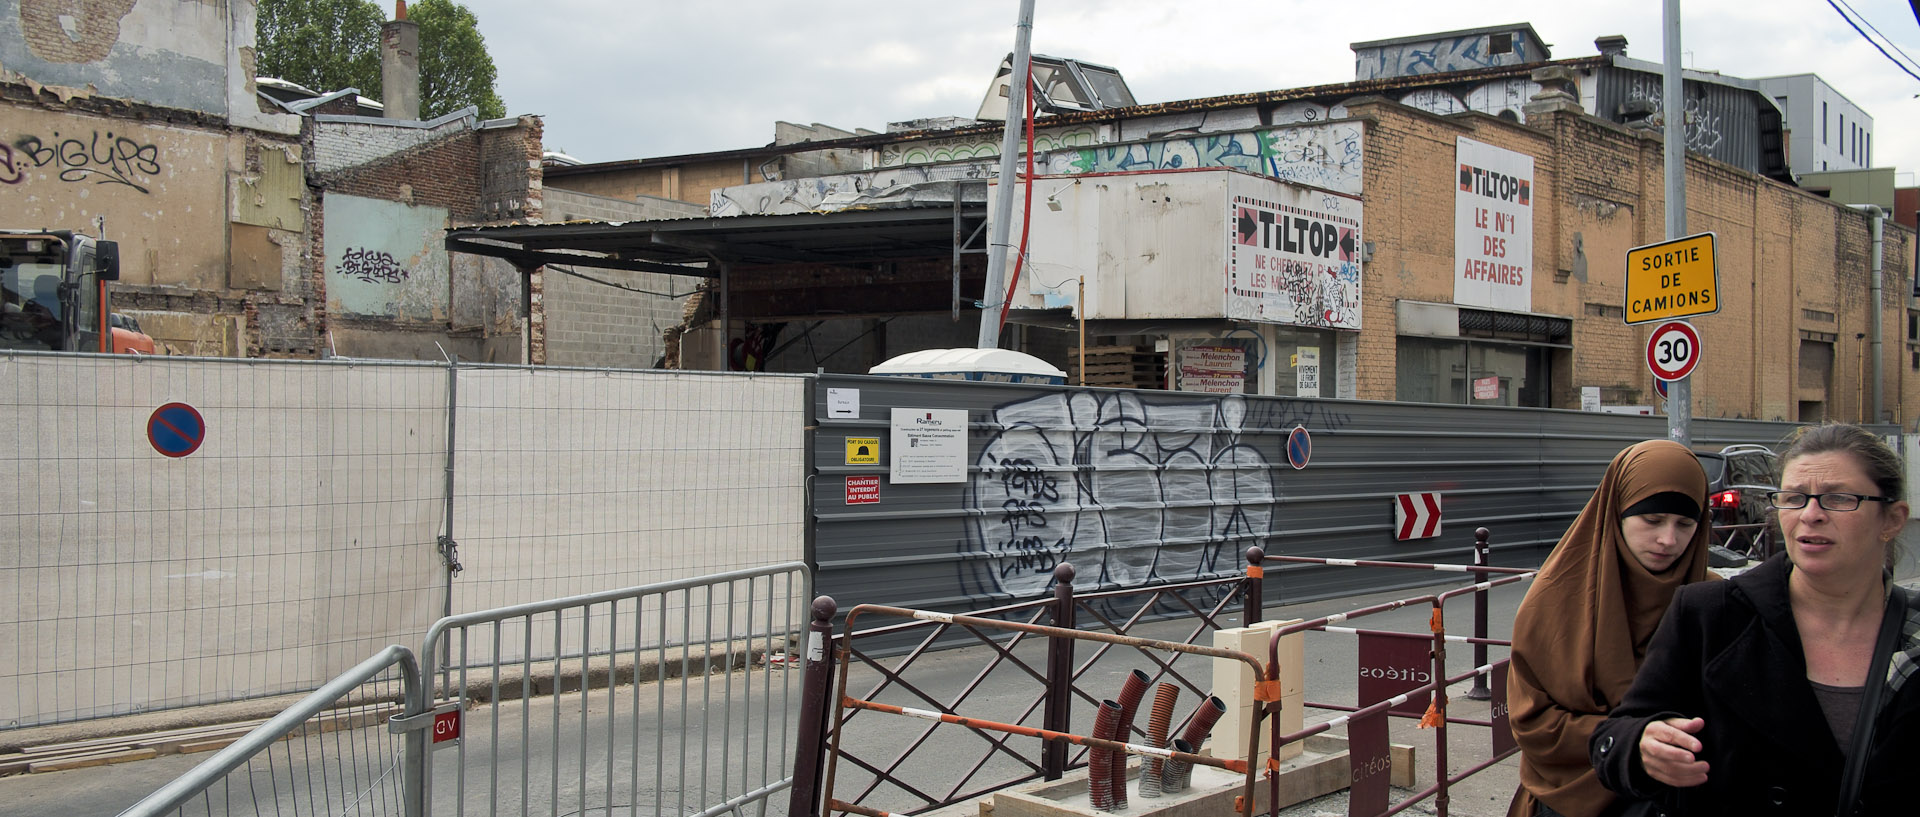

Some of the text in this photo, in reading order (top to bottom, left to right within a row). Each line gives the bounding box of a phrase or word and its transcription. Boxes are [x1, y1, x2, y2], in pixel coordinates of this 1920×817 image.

[1475, 207, 1515, 235] LE N°1
[1483, 235, 1506, 258] DES
[1255, 254, 1266, 270] NE
[1642, 247, 1700, 271] SORTIE
[1250, 272, 1267, 289] LES
[1464, 258, 1523, 286] AFFAIRES
[1661, 272, 1681, 289] DE
[1632, 289, 1711, 314] CAMIONS
[1200, 352, 1241, 361] Mélenchon
[1658, 338, 1689, 365] 30
[1204, 360, 1233, 368] Laurent
[1299, 365, 1318, 374] VIVEMENT
[1200, 378, 1240, 387] Mélenchon
[916, 418, 942, 426] Ramery
[1352, 754, 1391, 783] citéos
